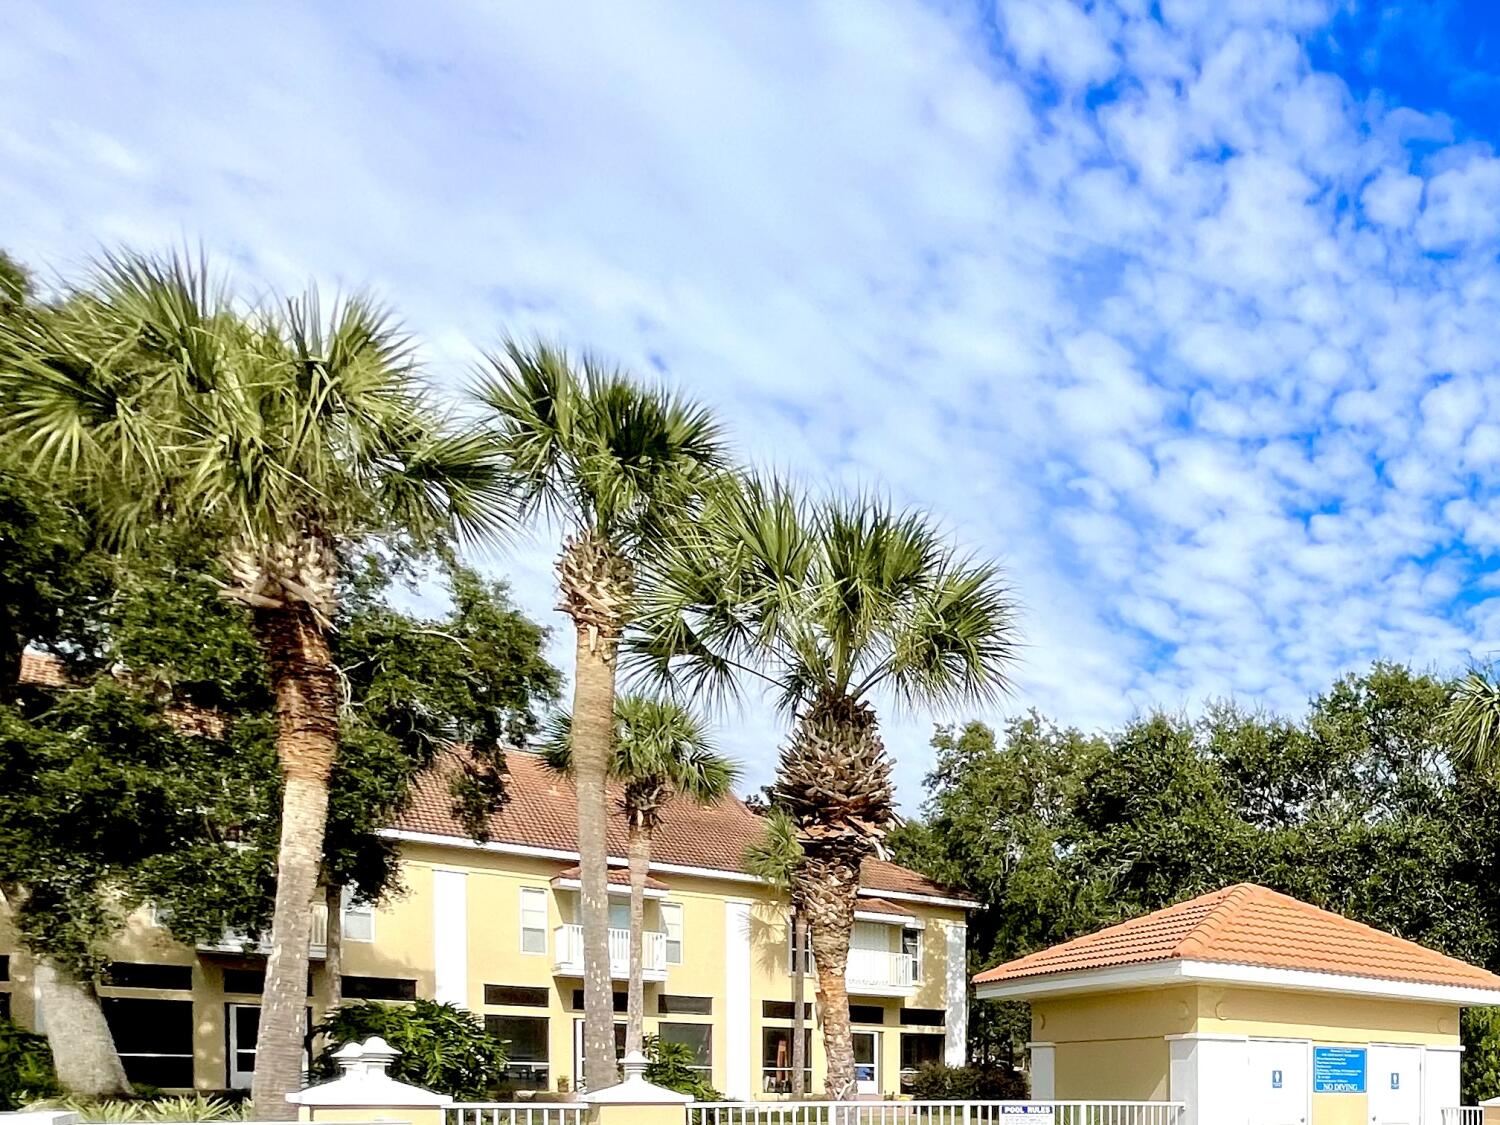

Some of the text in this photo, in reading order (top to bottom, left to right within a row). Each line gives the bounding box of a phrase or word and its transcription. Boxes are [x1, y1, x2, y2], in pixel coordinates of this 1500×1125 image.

[1323, 1083, 1358, 1091] NO DIVING
[1004, 1106, 1051, 1114] POOL RULES
